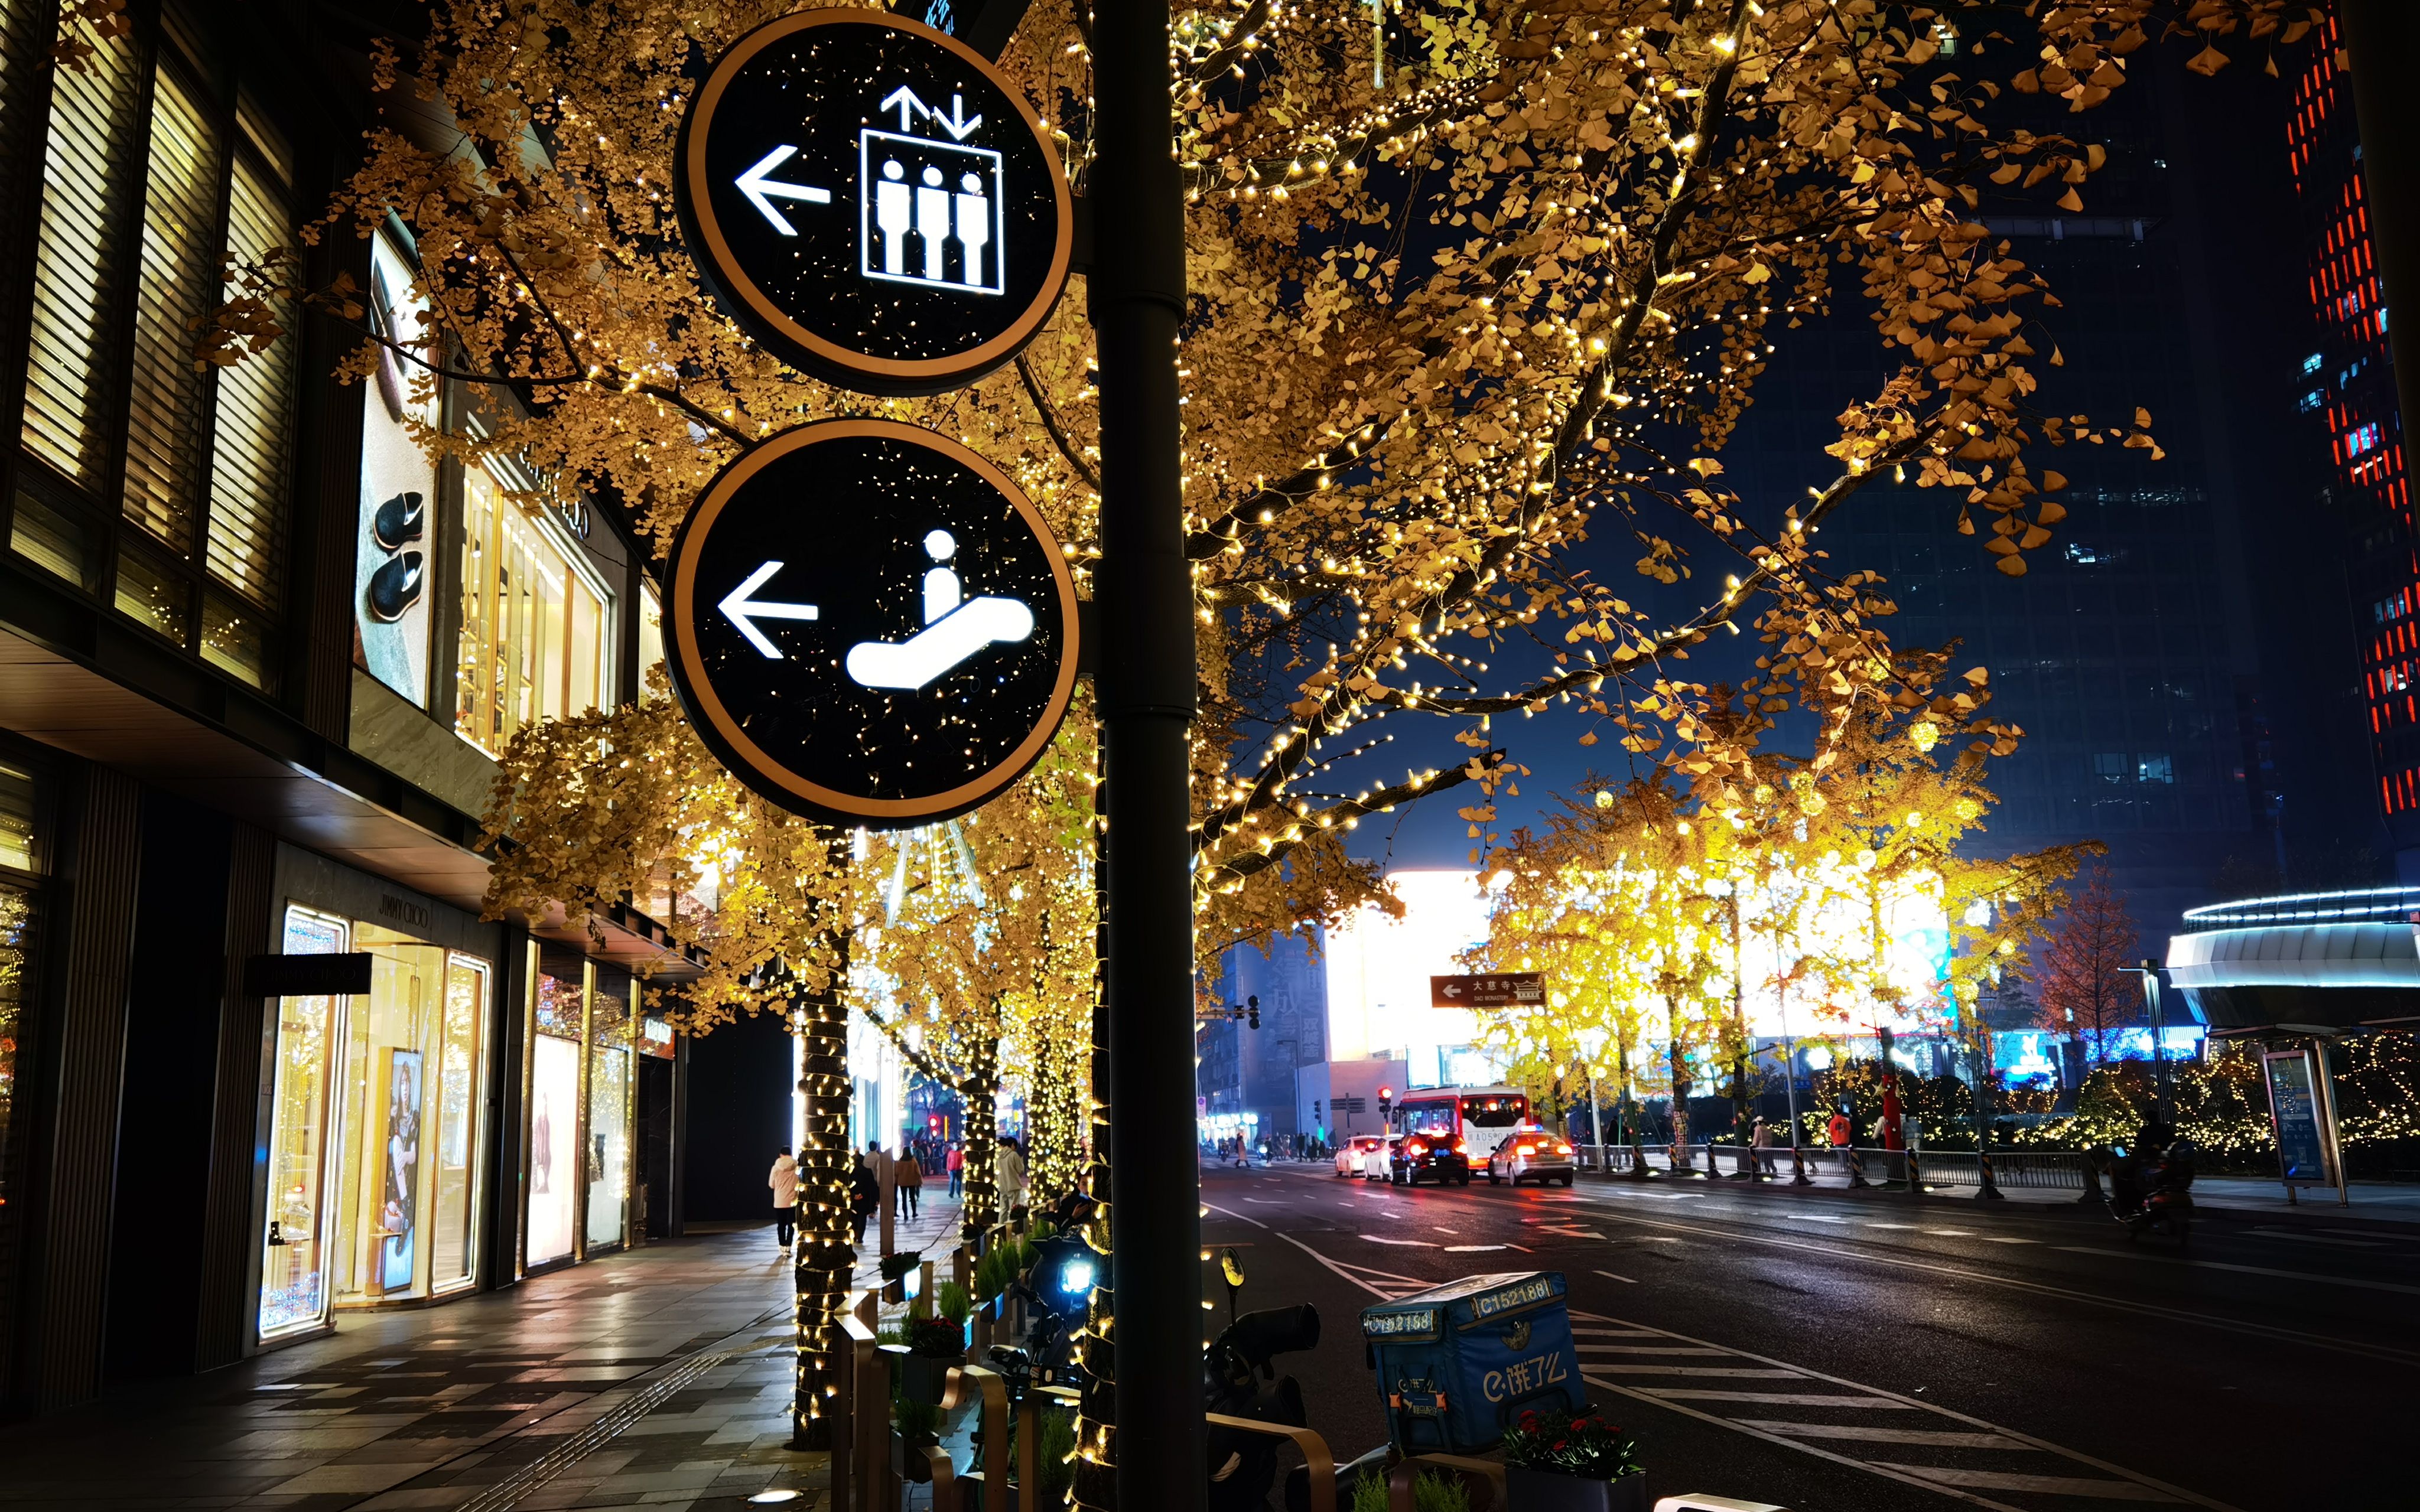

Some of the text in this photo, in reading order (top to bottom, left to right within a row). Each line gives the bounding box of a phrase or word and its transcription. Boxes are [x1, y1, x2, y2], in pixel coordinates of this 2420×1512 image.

[379, 894, 428, 928] JIMMY CHOO
[1473, 980, 1511, 990] 大慈寺
